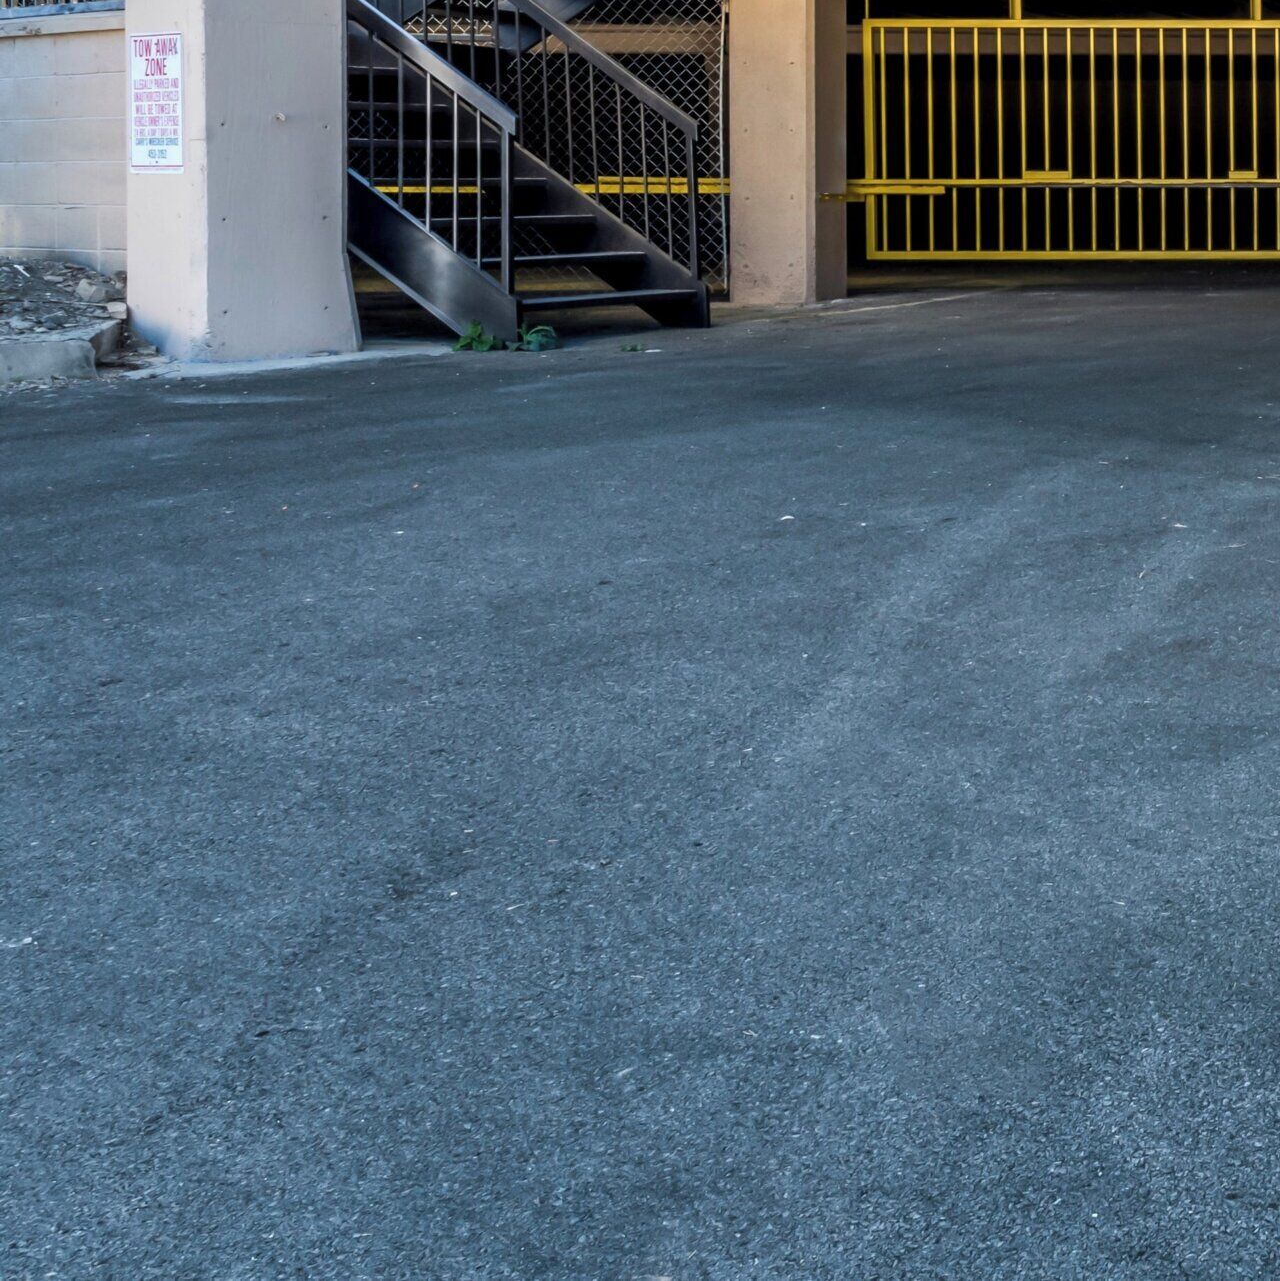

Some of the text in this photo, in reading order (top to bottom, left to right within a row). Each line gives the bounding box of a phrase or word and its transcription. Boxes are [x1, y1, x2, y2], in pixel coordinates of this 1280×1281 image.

[133, 37, 179, 58] TOW AWAY
[145, 58, 167, 76] ZONE
